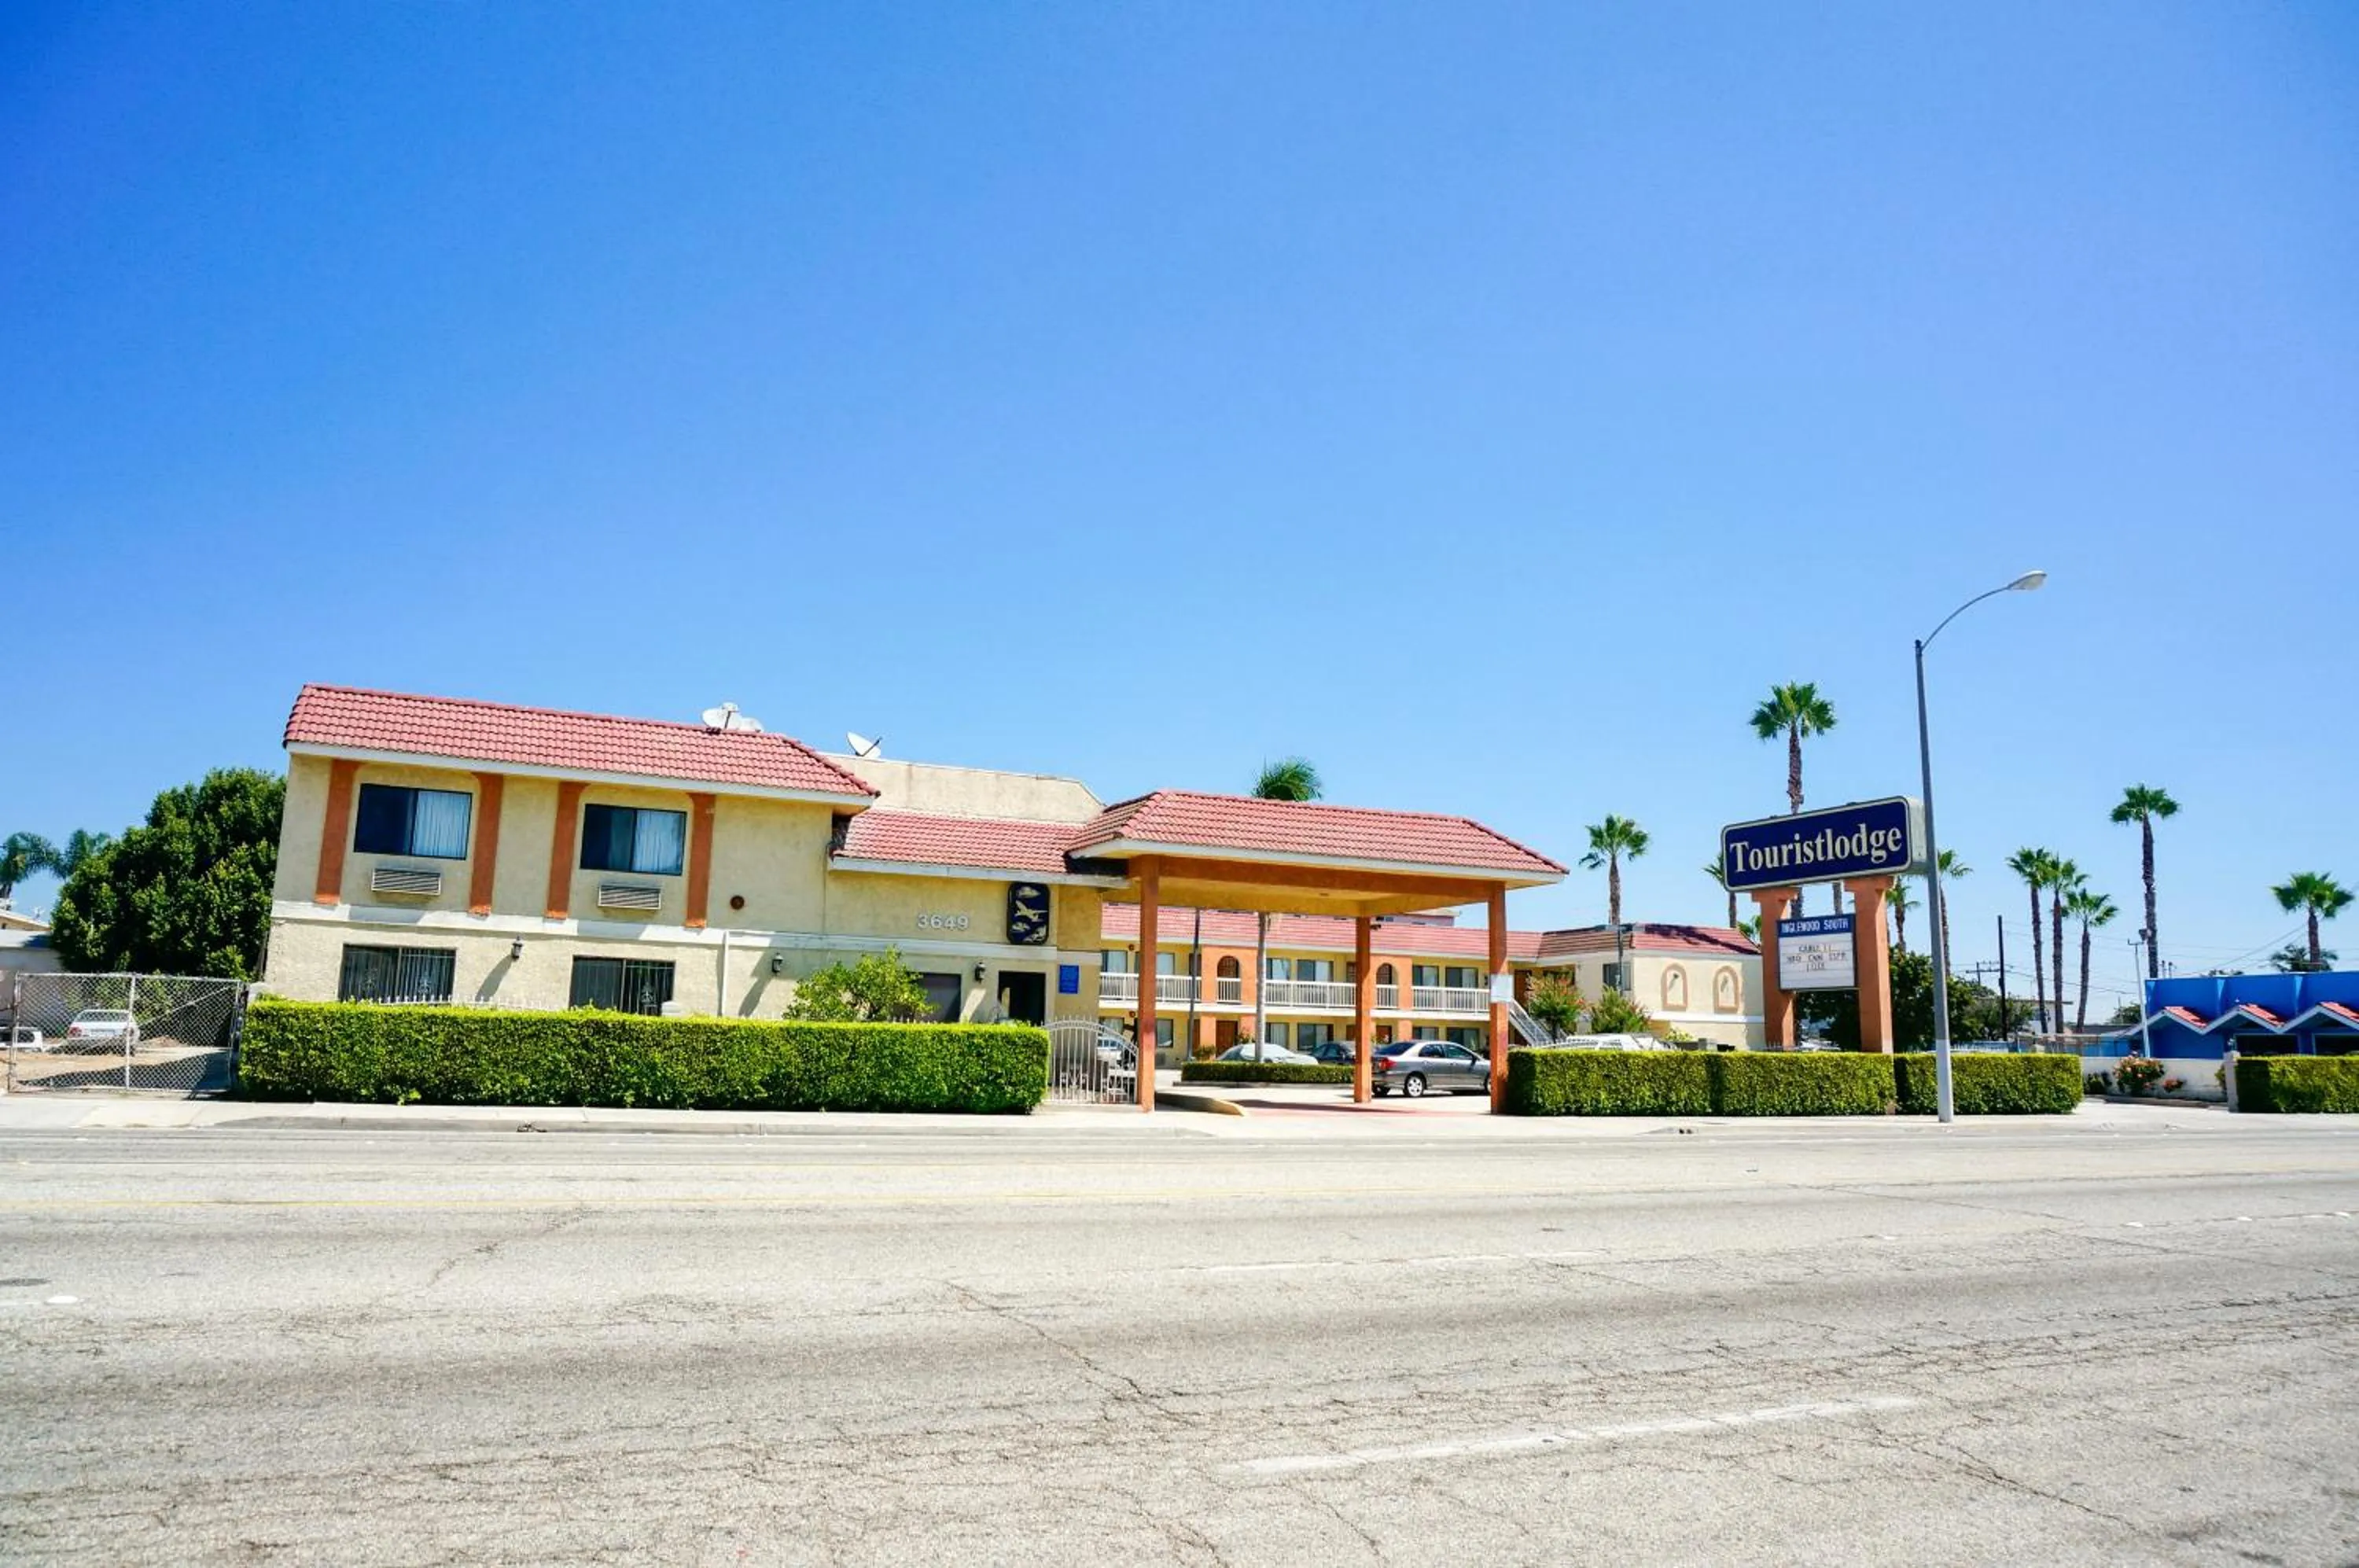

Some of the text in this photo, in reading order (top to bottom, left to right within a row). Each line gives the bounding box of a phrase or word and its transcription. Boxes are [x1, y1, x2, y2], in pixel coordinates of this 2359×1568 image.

[1730, 823, 1902, 872] Touristlodge
[918, 914, 970, 929] 3649
[1824, 918, 1849, 930] SOUTH
